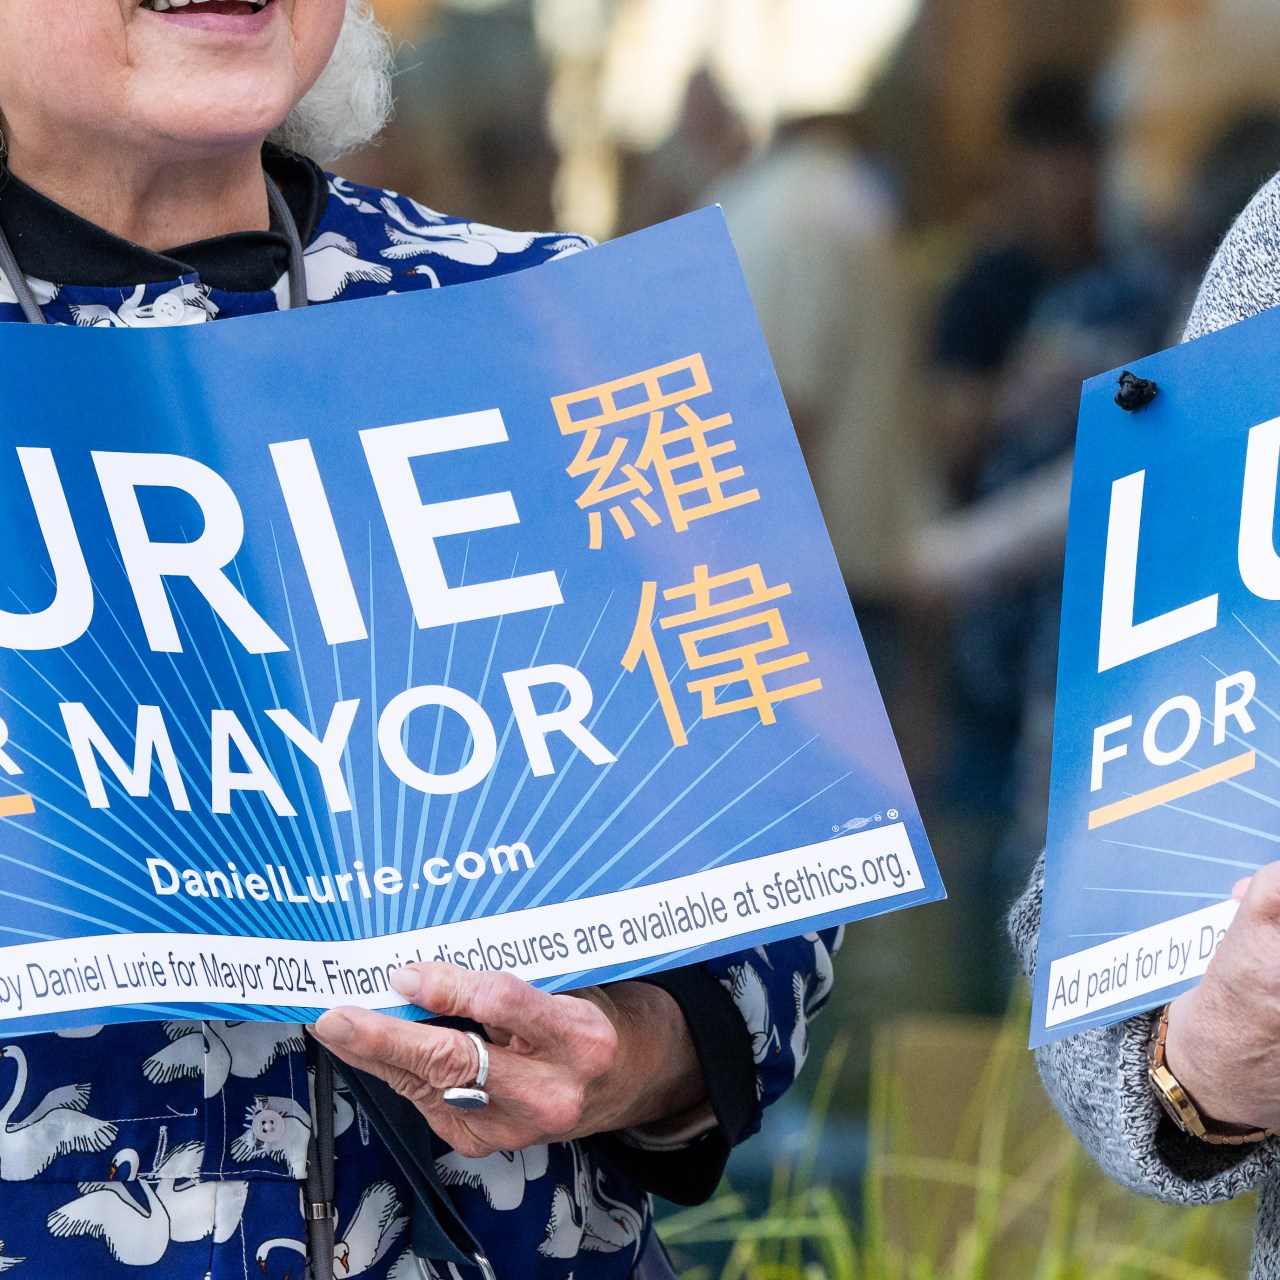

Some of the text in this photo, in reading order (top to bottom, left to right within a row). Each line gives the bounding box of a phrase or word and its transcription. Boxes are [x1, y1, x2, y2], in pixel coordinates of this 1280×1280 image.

[550, 352, 823, 748] 羅偉
[58, 663, 618, 818] MAYOR
[1089, 670, 1257, 793] FOR
[26, 953, 107, 998] Daniel
[107, 951, 167, 989] Lurie
[168, 951, 199, 987] for
[199, 951, 263, 998] Mayor
[265, 955, 324, 994] 2024.
[573, 923, 615, 955] are
[619, 891, 729, 946] available
[733, 881, 761, 918] at
[763, 851, 912, 911] sfethics.org.
[146, 841, 536, 904] DanielLurie.com
[1051, 969, 1081, 1010] Ad
[1086, 953, 1129, 1008] paid
[1135, 947, 1163, 982] for
[1167, 936, 1193, 976] by
